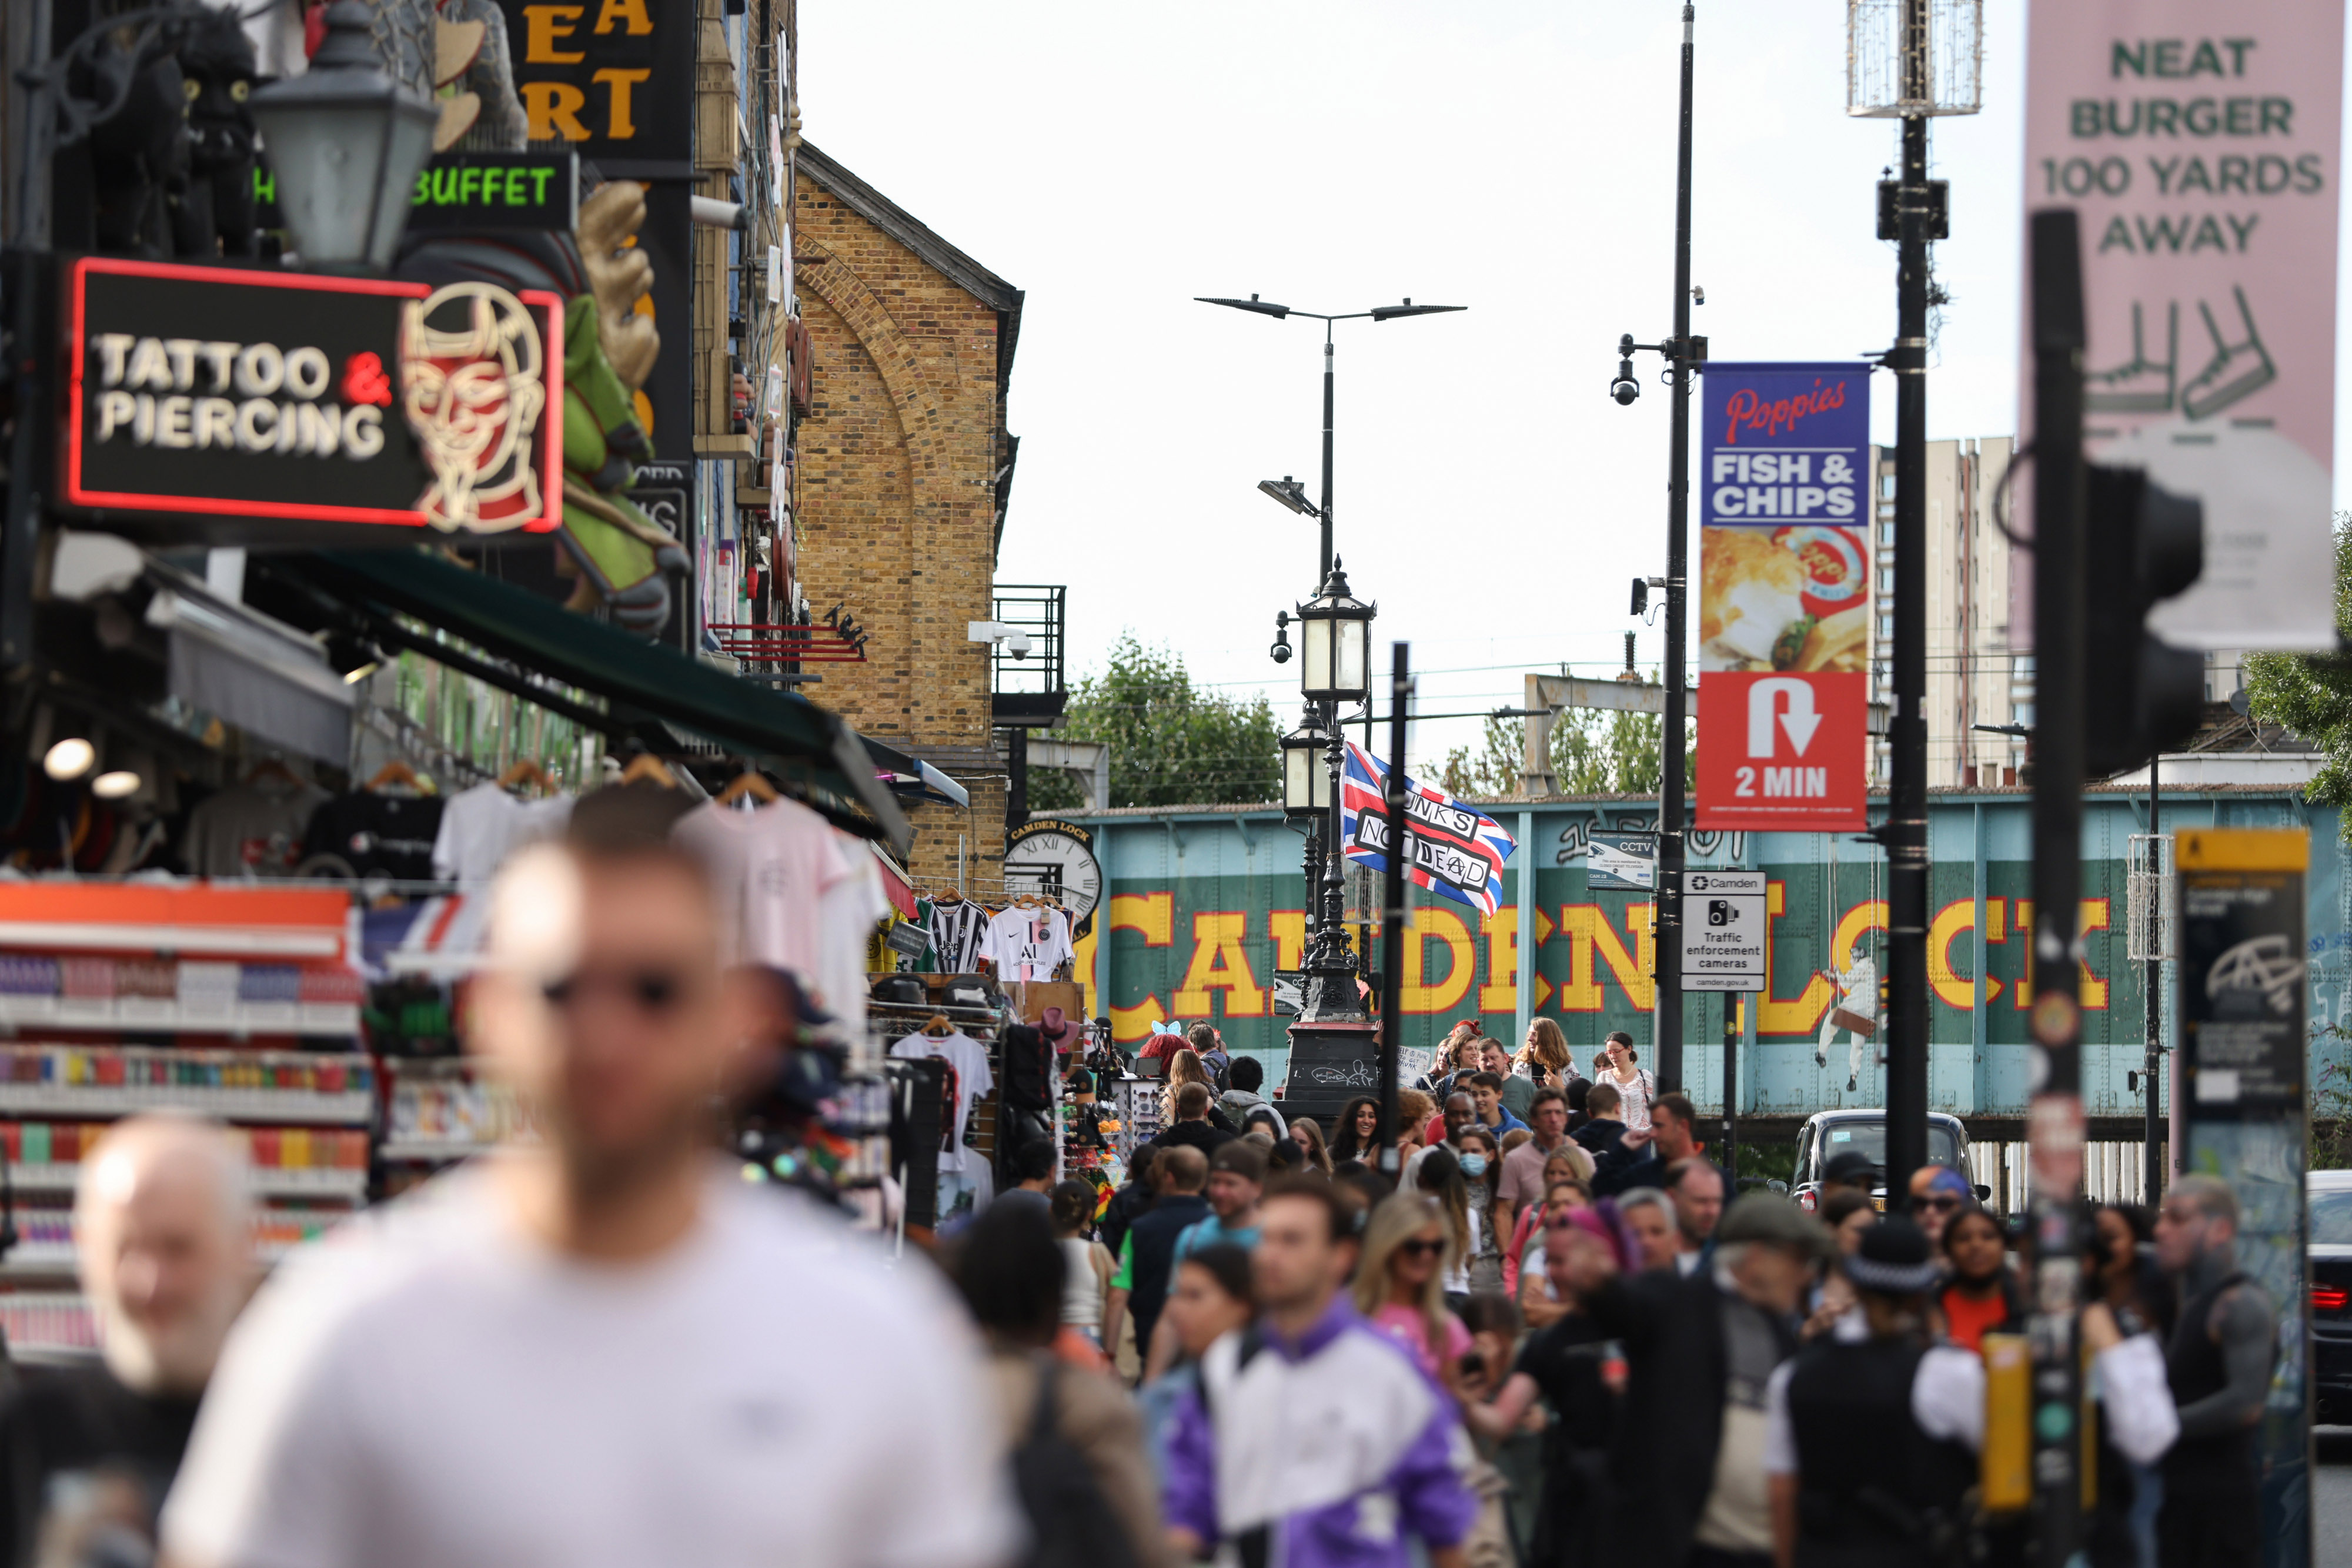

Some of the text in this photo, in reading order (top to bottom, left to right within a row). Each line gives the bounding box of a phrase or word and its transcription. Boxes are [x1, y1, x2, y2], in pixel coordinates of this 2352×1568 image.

[2110, 39, 2256, 79] NEAT
[2070, 98, 2293, 138] BURGER
[411, 166, 555, 206] BUFFET
[2042, 154, 2323, 196] 100 YARDS
[2099, 213, 2260, 254] AWAY
[91, 333, 393, 407] TATTOO &
[93, 390, 386, 460] PIERCING
[1726, 377, 1847, 444] Poppies
[1712, 454, 1856, 484] FISH &
[1712, 486, 1856, 516] CHIPS
[1735, 766, 1826, 797] 2 MIN
[1392, 785, 1471, 832] UNKS
[1011, 820, 1090, 842] CAMDEN LOCK
[1042, 837, 1058, 850] XII
[1620, 842, 1652, 851] CCTV
[1421, 842, 1485, 882] DEAD
[1710, 878, 1757, 888] Camden
[939, 941, 960, 952] Jeep
[1686, 945, 1760, 955] enforcement
[1704, 932, 1742, 942] Traffic
[1699, 959, 1748, 968] cameras
[1738, 881, 2110, 1036] LOCK
[1696, 979, 1749, 987] camden.gov.uk
[1396, 1058, 1417, 1071] DRUNK
[1397, 1047, 1409, 1055] HELP
